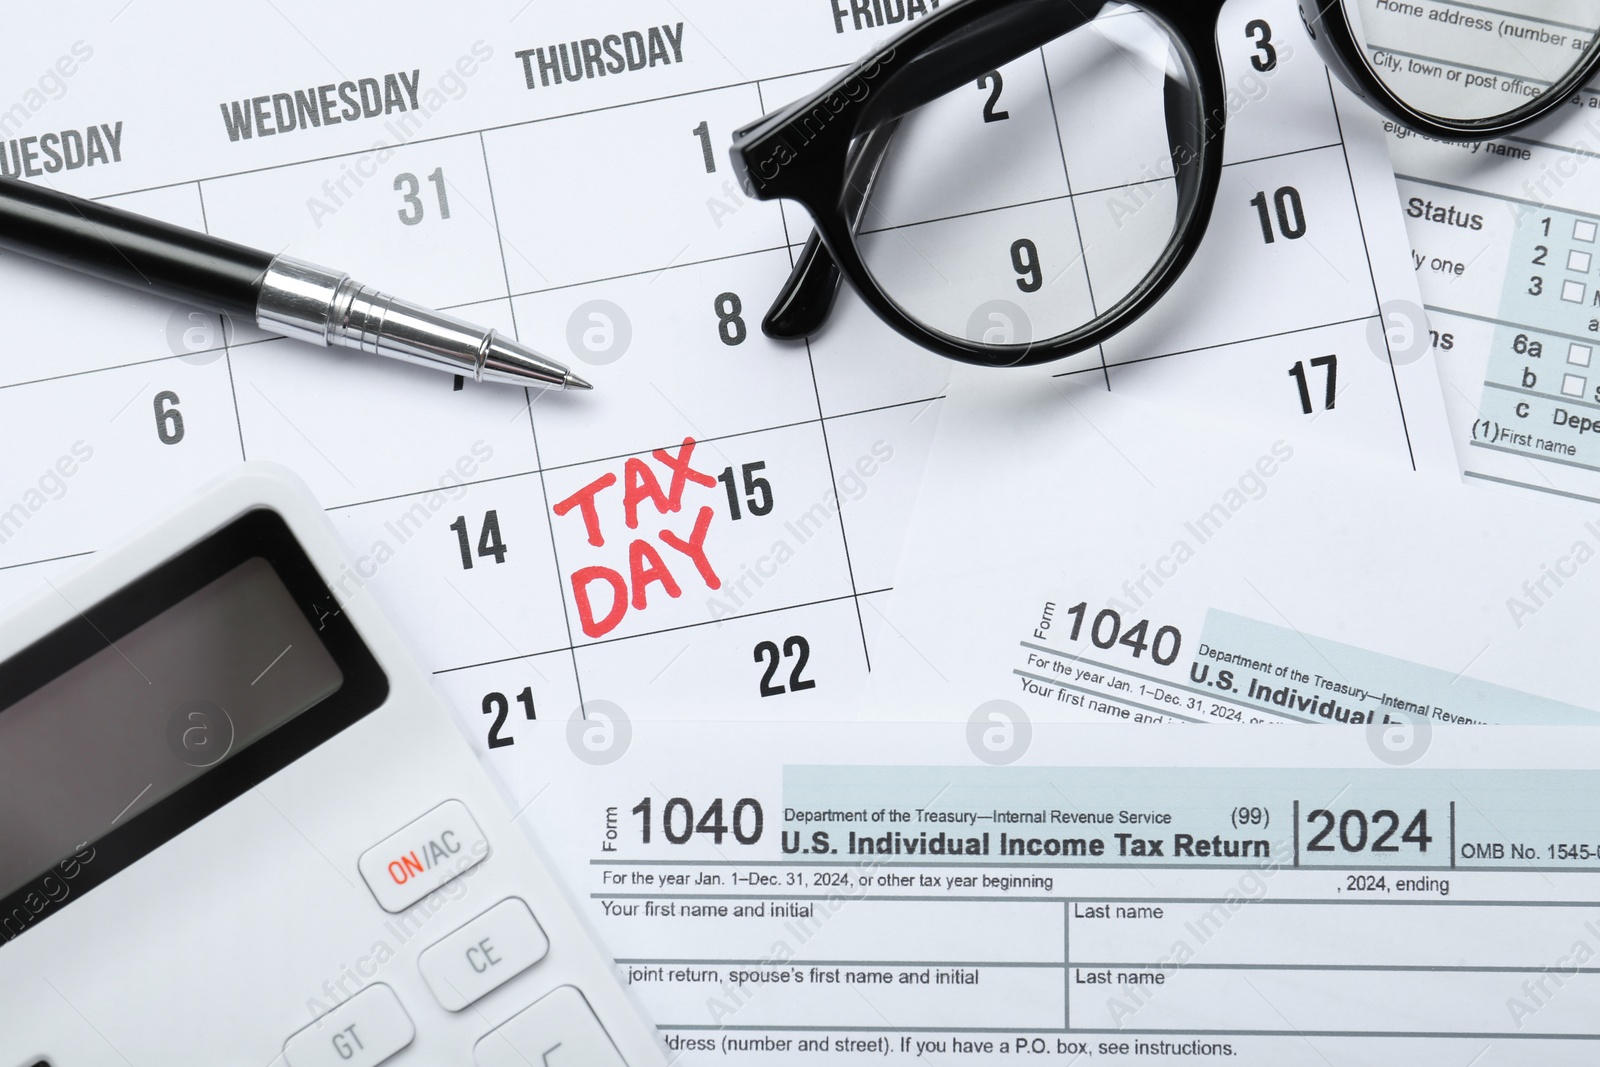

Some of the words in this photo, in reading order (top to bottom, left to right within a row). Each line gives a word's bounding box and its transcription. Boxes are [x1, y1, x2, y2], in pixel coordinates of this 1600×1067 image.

[1245, 19, 1277, 72] 3
[1429, 8, 1493, 32] address
[1499, 20, 1567, 46] (number
[515, 22, 685, 90] THURSDAY
[1373, 51, 1402, 72] City,
[1408, 59, 1442, 79] town
[1446, 71, 1462, 81] or
[1465, 73, 1497, 90] post
[220, 69, 420, 142] WEDNESDAY
[977, 70, 1009, 123] 2
[0, 121, 123, 180] UESDAY
[692, 121, 716, 173] 1
[1486, 142, 1532, 161] name
[393, 167, 450, 226] 31
[1250, 186, 1307, 244] 10
[1407, 197, 1484, 231] Status
[1541, 217, 1552, 237] 1
[1010, 238, 1043, 293] 9
[1431, 258, 1466, 276] one
[1532, 245, 1548, 266] 2
[1528, 276, 1543, 296] 3
[714, 292, 746, 346] 8
[1513, 334, 1543, 359] 6a
[1288, 355, 1337, 415] 17
[1521, 366, 1537, 388] b
[153, 390, 185, 445] 6
[1515, 402, 1530, 418] c
[1552, 408, 1600, 434] Depe
[1535, 438, 1577, 456] name
[553, 436, 717, 547] TAX
[718, 460, 774, 520] 15
[450, 509, 508, 570] 14
[571, 506, 721, 638] DAY
[1034, 601, 1056, 640] Form
[1067, 601, 1182, 666] 1040
[754, 635, 815, 699] 22
[1027, 654, 1049, 669] For
[1052, 659, 1073, 676] the
[1075, 668, 1105, 685] year
[1107, 676, 1133, 693] Jan.
[1186, 697, 1206, 715] 31,
[1199, 644, 1272, 675] Department
[1275, 666, 1289, 678] of
[1290, 669, 1310, 684] the
[1021, 677, 1057, 698] Your
[1057, 688, 1086, 708] first
[1088, 699, 1131, 719] name
[1190, 661, 1239, 694] U.S.
[1247, 678, 1375, 725] Individual
[482, 686, 537, 749] 21
[601, 806, 618, 852] Form
[630, 797, 764, 845] 1040
[784, 808, 867, 824] Department
[871, 808, 886, 822] of
[889, 808, 911, 823] the
[1051, 810, 1114, 824] Revenue
[1118, 810, 1172, 825] Service
[1231, 807, 1270, 829] (99)
[1306, 809, 1433, 853] 2024
[387, 830, 462, 885] ON/AC
[781, 830, 838, 855] U.S.
[848, 831, 990, 856] Individual
[1000, 832, 1105, 857] Income
[1114, 833, 1164, 857] Tax
[1174, 833, 1270, 858] Return
[1460, 843, 1504, 859] OMB
[1511, 844, 1541, 860] No.
[1548, 844, 1600, 860] 1545-
[603, 871, 628, 885] For
[632, 870, 654, 885] the
[658, 873, 691, 888] year
[695, 871, 725, 886] Jan.
[786, 872, 808, 888] 31,
[813, 873, 854, 888] 2024,
[858, 876, 874, 887] or
[877, 873, 915, 887] other
[919, 874, 942, 887] tax
[946, 876, 978, 890] year
[982, 874, 1054, 891] beginning
[1346, 876, 1390, 894] 2024,
[1396, 876, 1450, 896] ending
[601, 901, 640, 917] Your
[645, 901, 676, 917] first
[680, 904, 728, 917] name
[733, 902, 765, 917] and
[770, 902, 814, 918] initial
[1074, 902, 1110, 919] Last
[1115, 906, 1164, 919] name
[466, 937, 502, 973] CE
[628, 966, 664, 985] joint
[669, 967, 723, 984] return,
[728, 967, 804, 987] spouse’s
[809, 967, 840, 983] first
[845, 971, 893, 984] name
[898, 968, 930, 984] and
[936, 968, 979, 985] initial
[1076, 968, 1112, 985] Last
[1116, 972, 1165, 985] name
[331, 1024, 365, 1060] GT
[664, 1035, 716, 1050] dress
[721, 1034, 792, 1055] (number
[797, 1035, 830, 1052] and
[834, 1036, 894, 1055] street).
[900, 1037, 912, 1053] If
[915, 1041, 947, 1057] you
[951, 1037, 994, 1054] have
[999, 1042, 1010, 1053] a
[1015, 1038, 1051, 1054] P.O.
[1056, 1038, 1093, 1057] box,
[1098, 1043, 1130, 1055] see
[1134, 1039, 1238, 1057] instructions.
